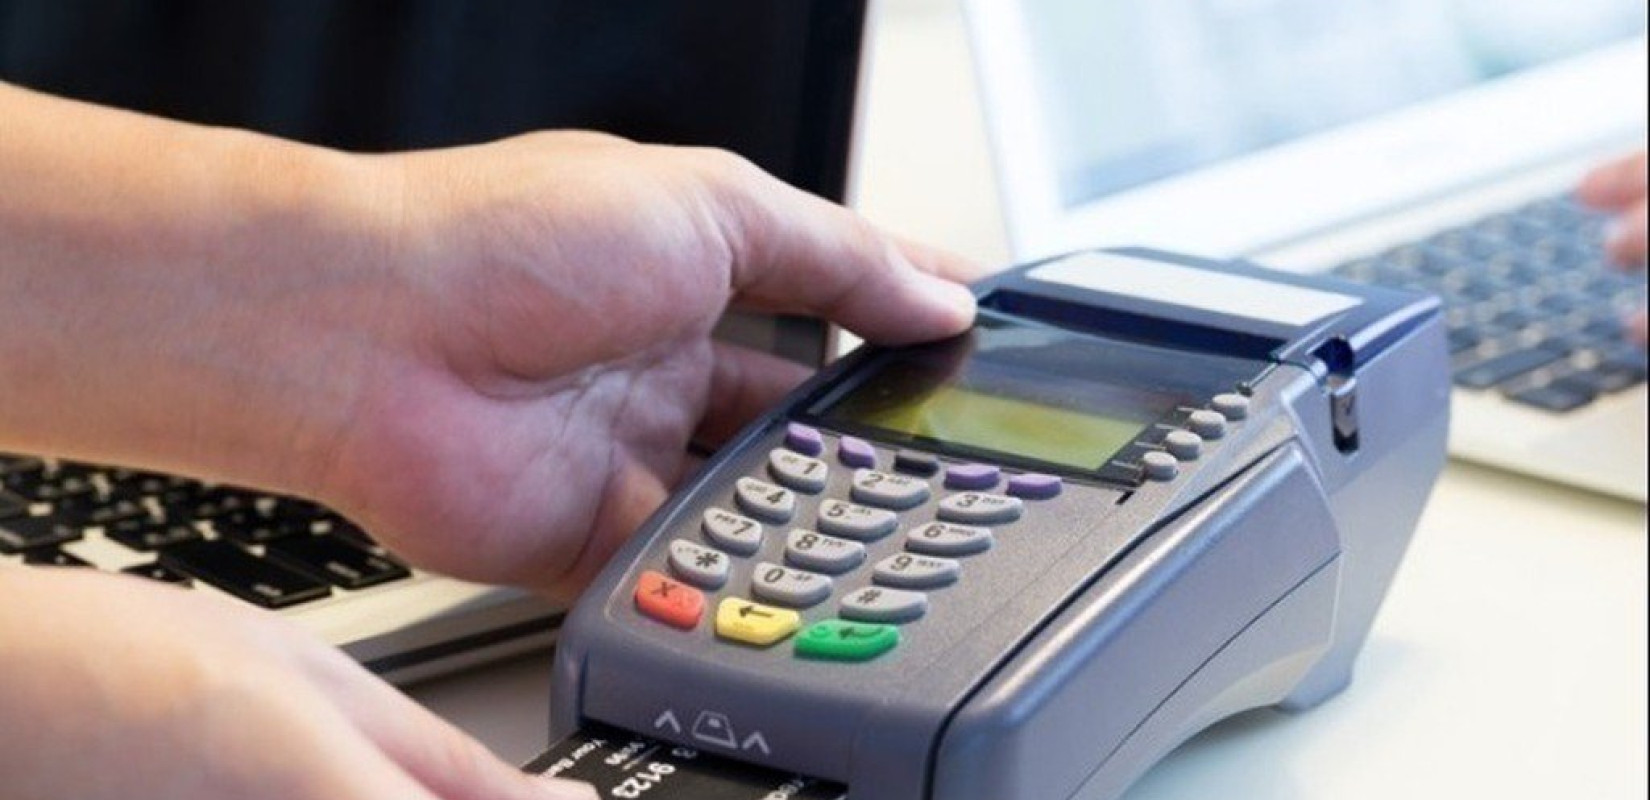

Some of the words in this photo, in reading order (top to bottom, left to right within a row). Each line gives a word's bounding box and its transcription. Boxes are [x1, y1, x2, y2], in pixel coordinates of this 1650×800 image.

[803, 462, 819, 475] 1
[862, 472, 885, 488] 2
[766, 490, 786, 504] 4
[957, 494, 979, 508] 3
[827, 502, 849, 517] 5
[732, 521, 755, 536] 7
[924, 523, 946, 538] 6
[795, 533, 820, 551] 8
[890, 554, 913, 571] 9
[763, 567, 786, 583] 0
[611, 762, 676, 798] 9123
